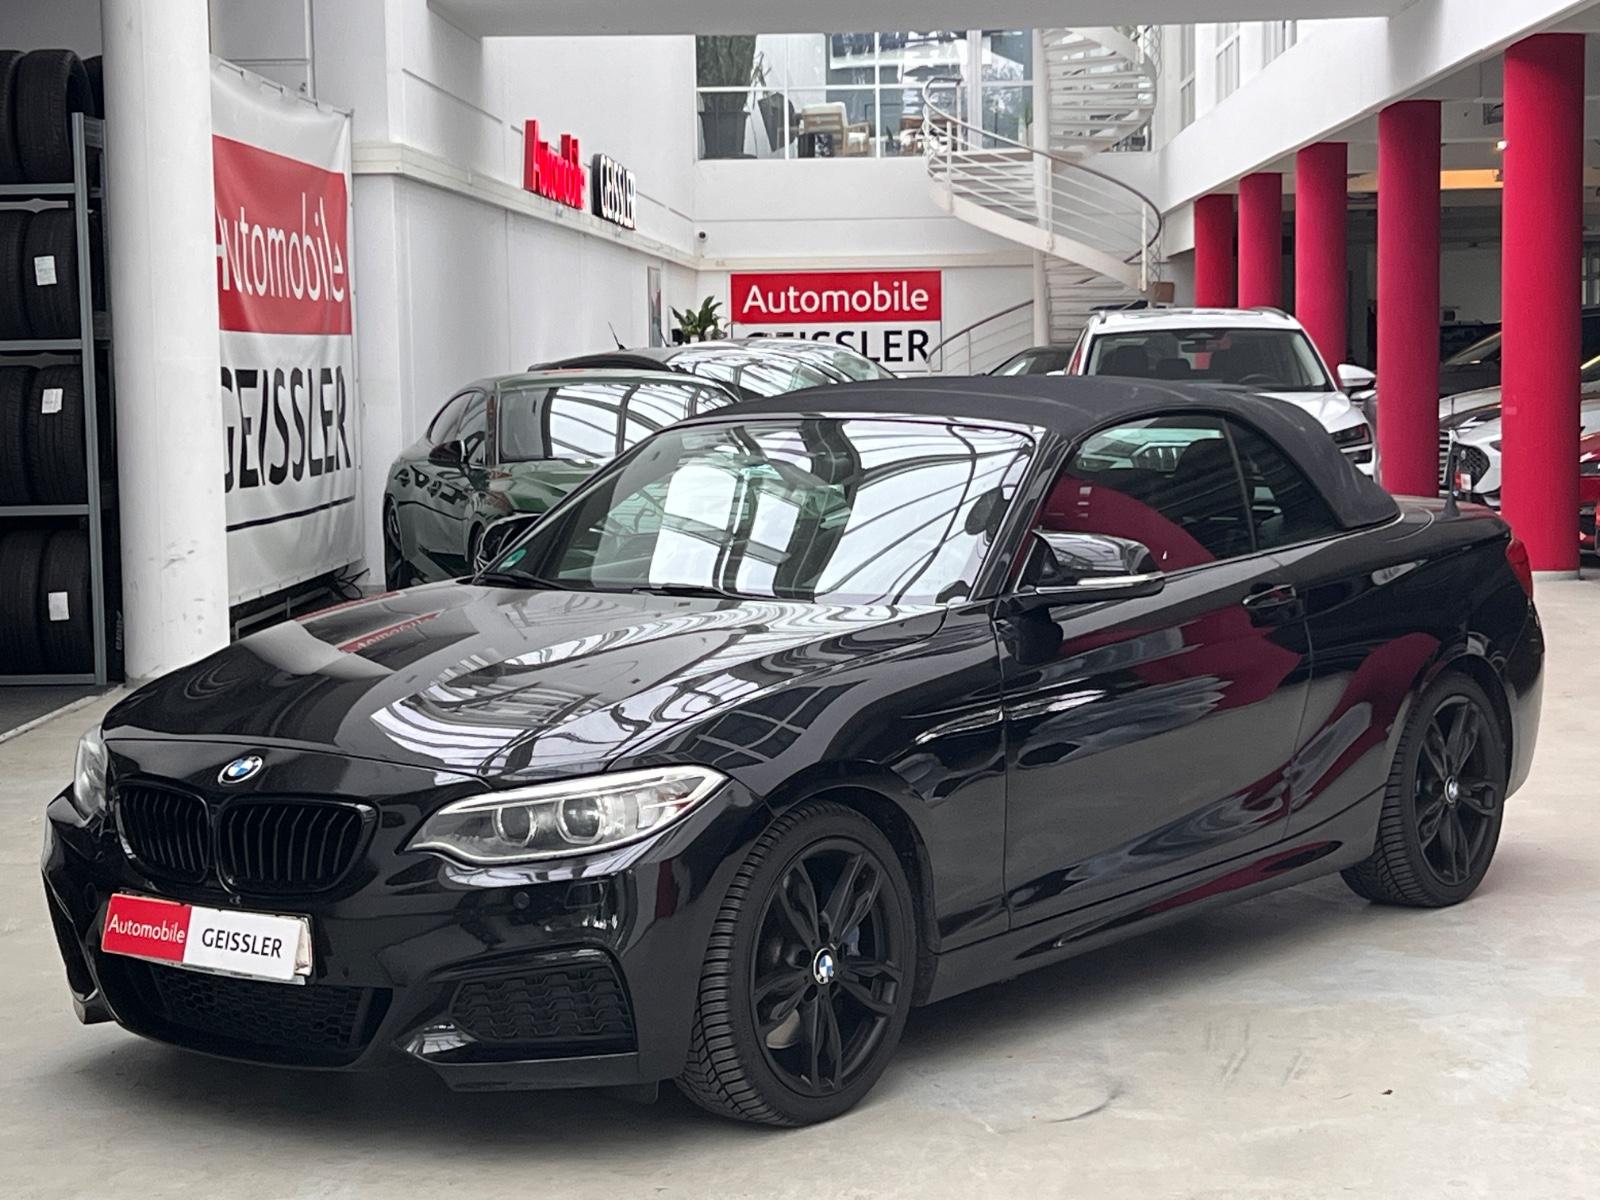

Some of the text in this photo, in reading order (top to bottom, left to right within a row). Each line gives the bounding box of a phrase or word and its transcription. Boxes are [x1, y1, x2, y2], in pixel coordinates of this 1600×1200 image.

[742, 280, 930, 314] Automobile
[747, 329, 930, 363] SLER
[107, 913, 283, 959] Automobile GEISSLER
